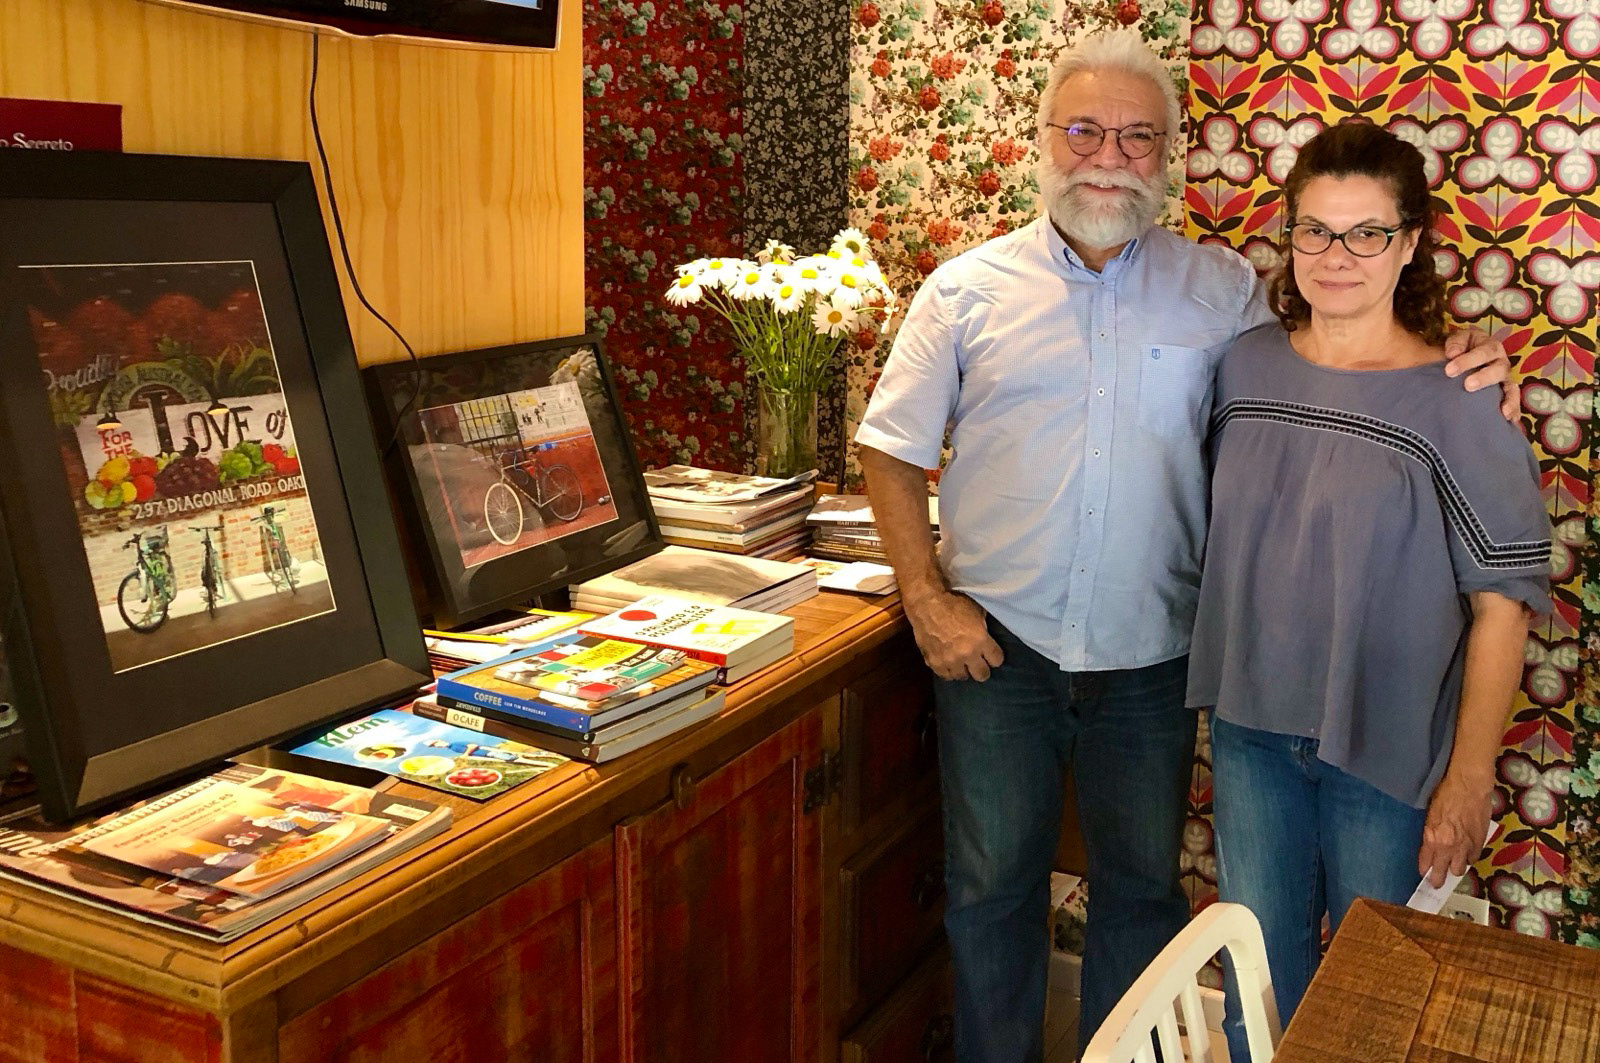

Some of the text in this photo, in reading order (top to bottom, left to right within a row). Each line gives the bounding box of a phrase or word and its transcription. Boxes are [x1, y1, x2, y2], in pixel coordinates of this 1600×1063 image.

[344, 0, 388, 12] SAMSUNG
[98, 429, 133, 450] FOR
[132, 500, 163, 520] 297
[167, 487, 238, 514] DIAGONAL
[239, 482, 272, 502] ROAD
[473, 691, 503, 707] COFFEE
